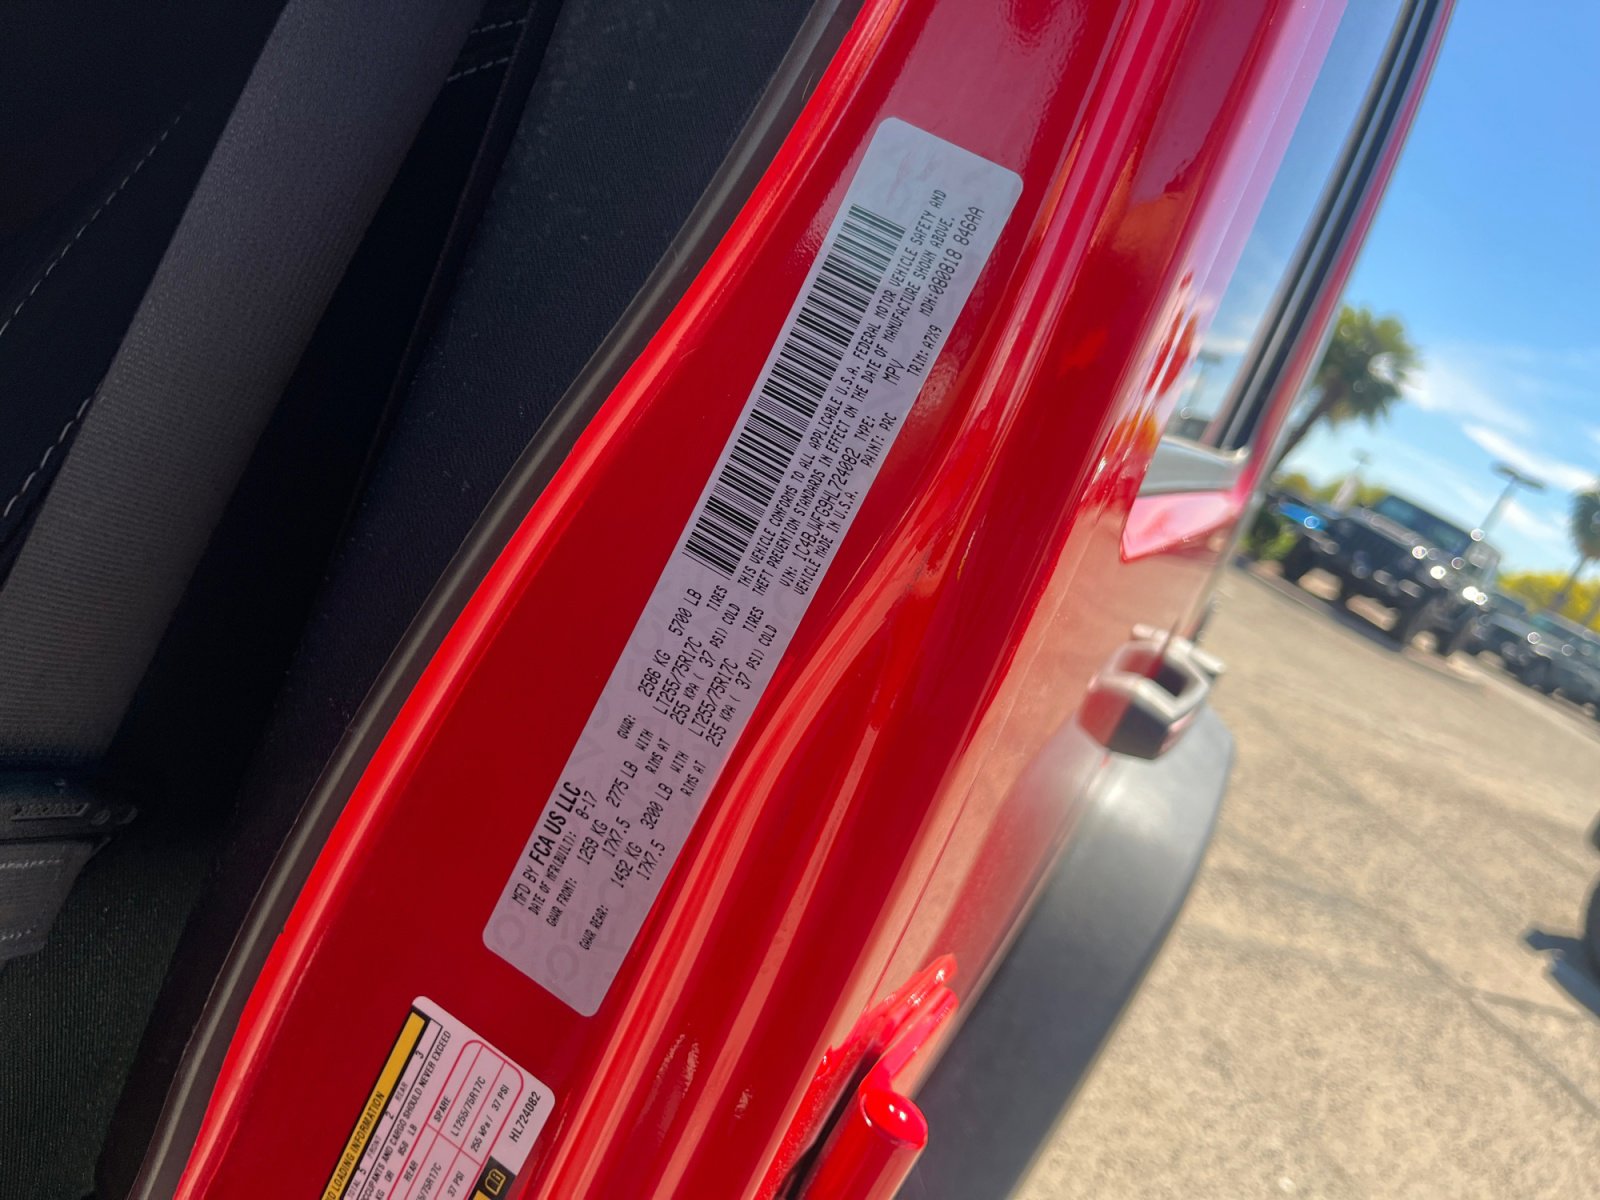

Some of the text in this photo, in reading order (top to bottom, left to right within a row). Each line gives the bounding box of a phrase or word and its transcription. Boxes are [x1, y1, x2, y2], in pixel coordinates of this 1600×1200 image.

[737, 189, 946, 587] THIS VEHICLE CONFORMS TO ALL APPLICABLE U.S.A. FEDERAL MOTOR VEHICLE SAFETY AND
[751, 217, 954, 595] THEFT PREVENTION STANDARDS IN EFFECT ON THE DATE OF MANUFACTURE SHOWN ABOVE.
[778, 566, 797, 586] VIN:
[791, 447, 861, 561] 1C4BJWFG9HL724082
[853, 415, 875, 441] TYPE:
[881, 358, 905, 385] MPV
[952, 206, 984, 245] 846AA
[793, 324, 942, 594] VEHICLE MADE IN U.S.A. PAINT: PRC TRIM: A7X9
[616, 588, 702, 739] GVWR: 2586 KG 5700 LB
[545, 584, 727, 926] GAWR FRONT: 1259 KG 2775 LB WITH LT255/75R17C TIRES
[578, 606, 764, 950] GAWR REAR: 1452 KG 3200 LB WITH LT255/75R17C TIRES
[601, 815, 630, 857] 17X7.5
[644, 751, 663, 774] RIMS
[656, 737, 670, 752] AT
[669, 699, 690, 725] 255
[683, 682, 699, 700] KPA
[698, 649, 715, 667] 37
[709, 627, 727, 648] PSI)
[721, 602, 740, 625] COLD
[635, 838, 665, 880] 17X7.5
[679, 773, 699, 796] RIMS
[692, 759, 705, 774] AT
[705, 721, 726, 747] 255
[719, 704, 736, 722] KPA
[734, 671, 752, 689] 37
[745, 648, 764, 670] PSI)
[758, 624, 777, 646] COLD
[511, 781, 580, 905] MFD BY FCA US LLC
[527, 790, 597, 915] DATE OF MFR(BUILT): 8-17
[331, 1152, 355, 1192] LOADING
[349, 1090, 384, 1153] INFORMATION
[347, 1179, 361, 1198] TOTAL
[364, 1134, 381, 1158] FRONT
[394, 1081, 408, 1101] REAR
[360, 1030, 451, 1200] CCUPANTS AND CARGO SHOULD NEVER EXCEED
[384, 1169, 394, 1182] OR
[407, 1123, 417, 1136] LB
[433, 1095, 450, 1122] SPARE
[450, 1075, 485, 1136] LT255/75R17C
[470, 1135, 482, 1152] 255
[478, 1121, 490, 1136] kPa
[491, 1098, 501, 1111] 37
[497, 1083, 509, 1100] PSI
[508, 1090, 541, 1142] HL724082
[403, 1159, 418, 1182] REAR
[416, 1160, 443, 1200] 5/75R17C
[447, 1170, 464, 1197] 37 PSI
